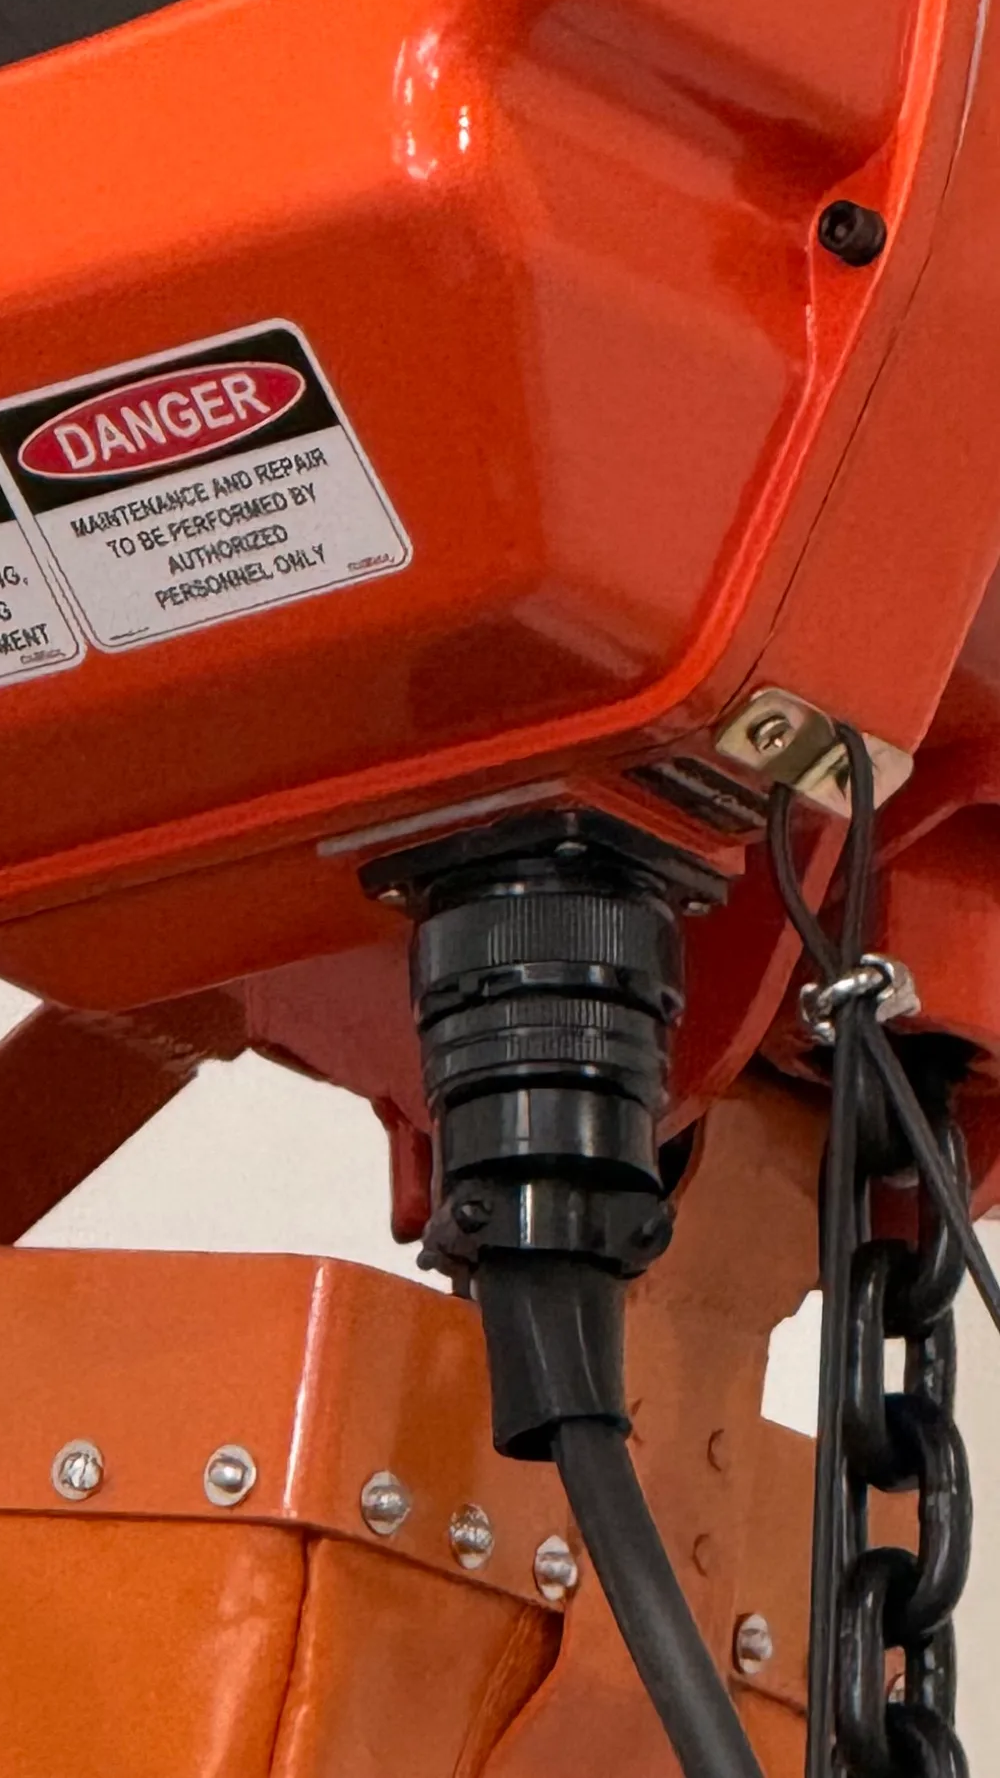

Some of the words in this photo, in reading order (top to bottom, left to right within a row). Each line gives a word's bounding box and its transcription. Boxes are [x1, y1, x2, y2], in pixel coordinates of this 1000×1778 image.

[53, 372, 272, 471] DANGER
[70, 481, 210, 540] MAINTENANCE
[213, 469, 253, 498] AND
[254, 446, 329, 486] REPAIR
[106, 531, 137, 559] TO
[138, 526, 170, 553] BE
[169, 491, 289, 539] PERFORMED
[287, 482, 319, 507] BY
[155, 561, 274, 611] PERSONNEL
[275, 542, 328, 576] ONLY
[167, 522, 290, 576] AUTHORIZED
